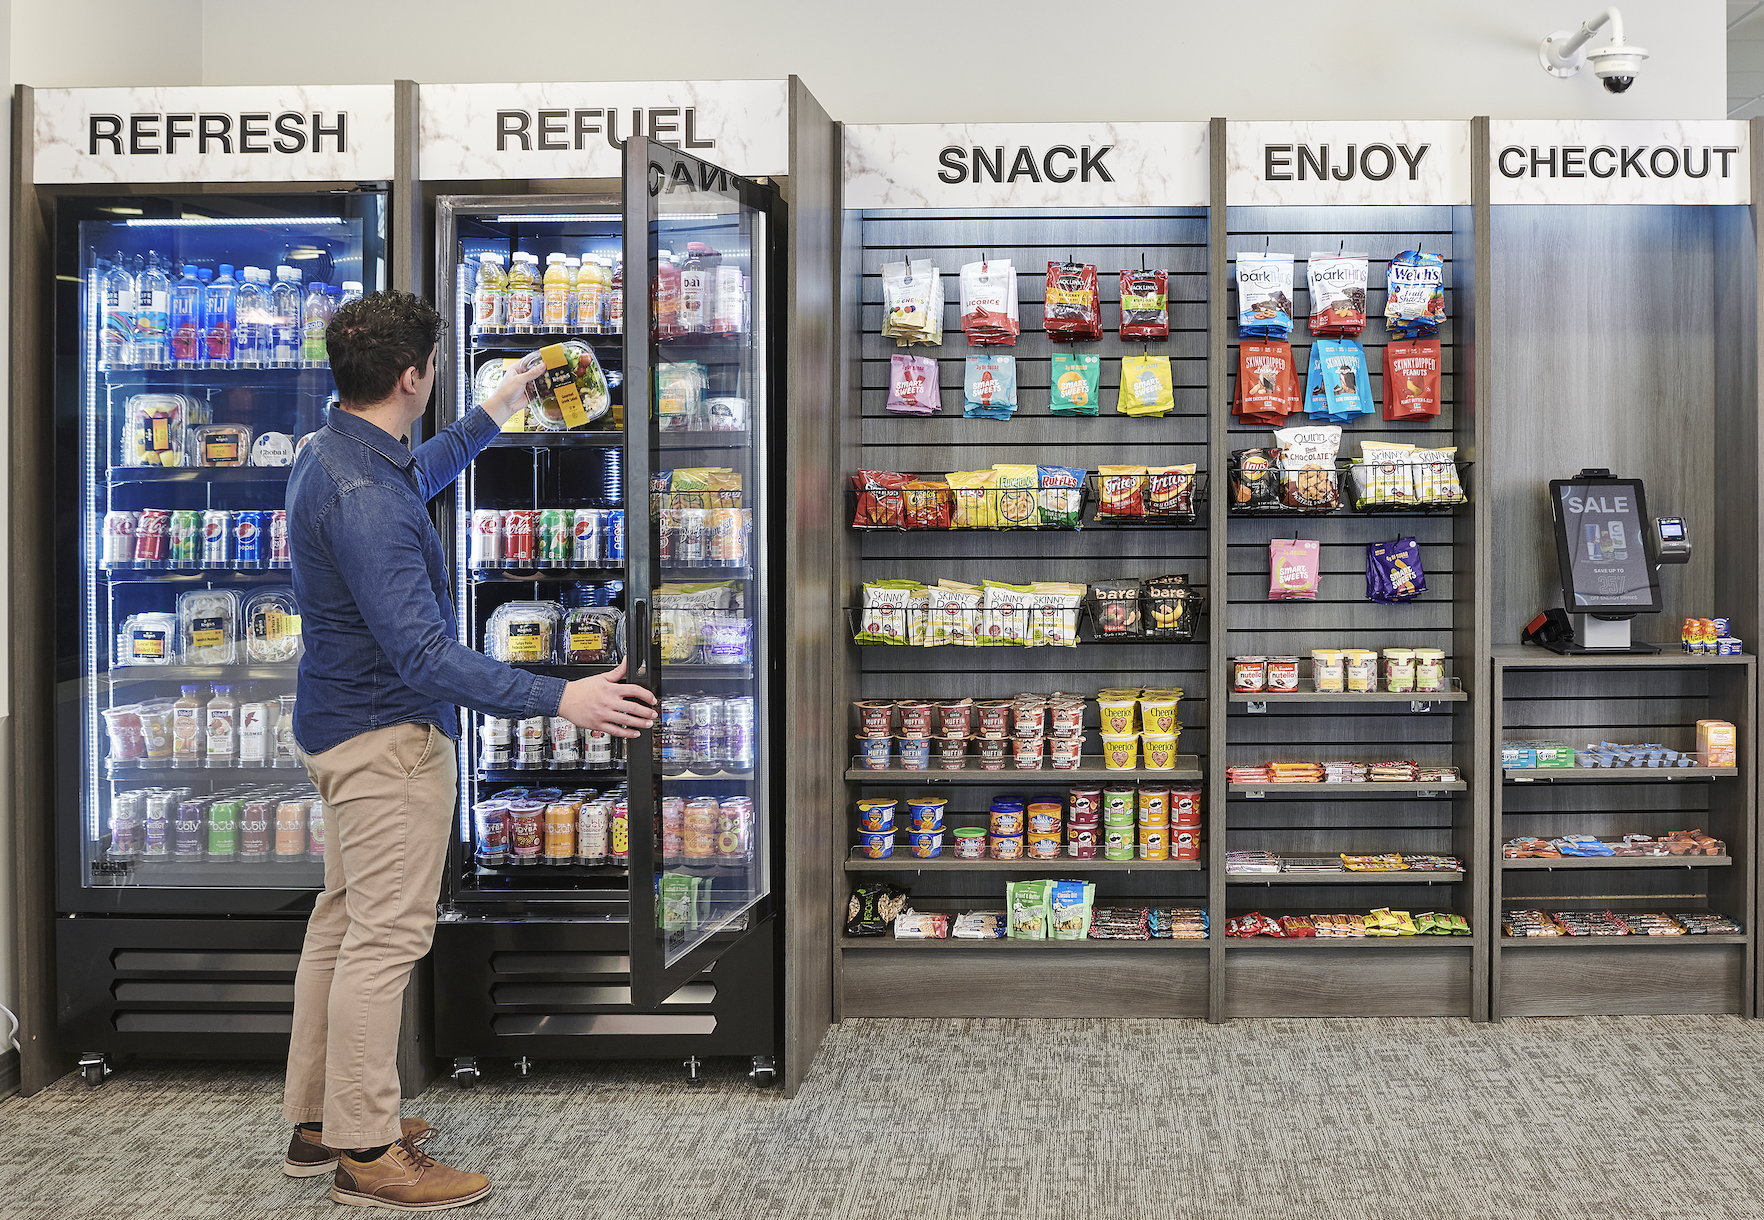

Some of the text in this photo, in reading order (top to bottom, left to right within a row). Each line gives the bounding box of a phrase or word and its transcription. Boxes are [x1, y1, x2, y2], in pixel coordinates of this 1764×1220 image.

[89, 111, 348, 155] REFRESH
[496, 107, 715, 151] REFUEL
[937, 144, 1115, 184] SNACK
[1265, 143, 1431, 181] ENJOY
[1498, 145, 1739, 178] CHECKOUT
[1394, 267, 1440, 281] Welch's
[683, 276, 700, 287] bai
[173, 298, 193, 313] FIJI
[208, 297, 229, 313] FIJI
[966, 299, 1000, 307] LICORICE
[1245, 356, 1286, 370] SKINNYDIPPED
[1393, 357, 1436, 372] SKINNYDIPPED
[894, 386, 925, 397] SWEETS
[972, 385, 1002, 397] SWEETS
[1060, 385, 1090, 398] SWEETS
[1134, 384, 1163, 398] SWEETS
[1290, 453, 1329, 462] CHOCOLATE
[1371, 450, 1404, 461] SKINNY
[1418, 451, 1450, 463] SKINNY
[1042, 475, 1078, 489] RUFFLES
[1104, 476, 1138, 495] Fritos
[1568, 496, 1629, 514] SALE
[612, 518, 624, 550] pepsi
[237, 544, 255, 552] pepsi
[1279, 571, 1309, 584] SWEETS
[1392, 571, 1417, 590] SWEETS
[1597, 575, 1629, 595] 25%
[873, 590, 906, 603] SKINNY
[937, 590, 970, 602] SKINNY
[991, 590, 1025, 603] SKINNY
[1095, 588, 1136, 600] bare
[1150, 586, 1185, 599] bare
[1033, 595, 1066, 604] SKINNY
[1104, 706, 1132, 717] Cheerios
[944, 717, 965, 725] MUFFIN
[1106, 741, 1134, 751] Cheerios
[1146, 741, 1174, 751] Cheerios
[942, 749, 963, 757] MUFFIN
[982, 749, 1003, 757] MUFFIN
